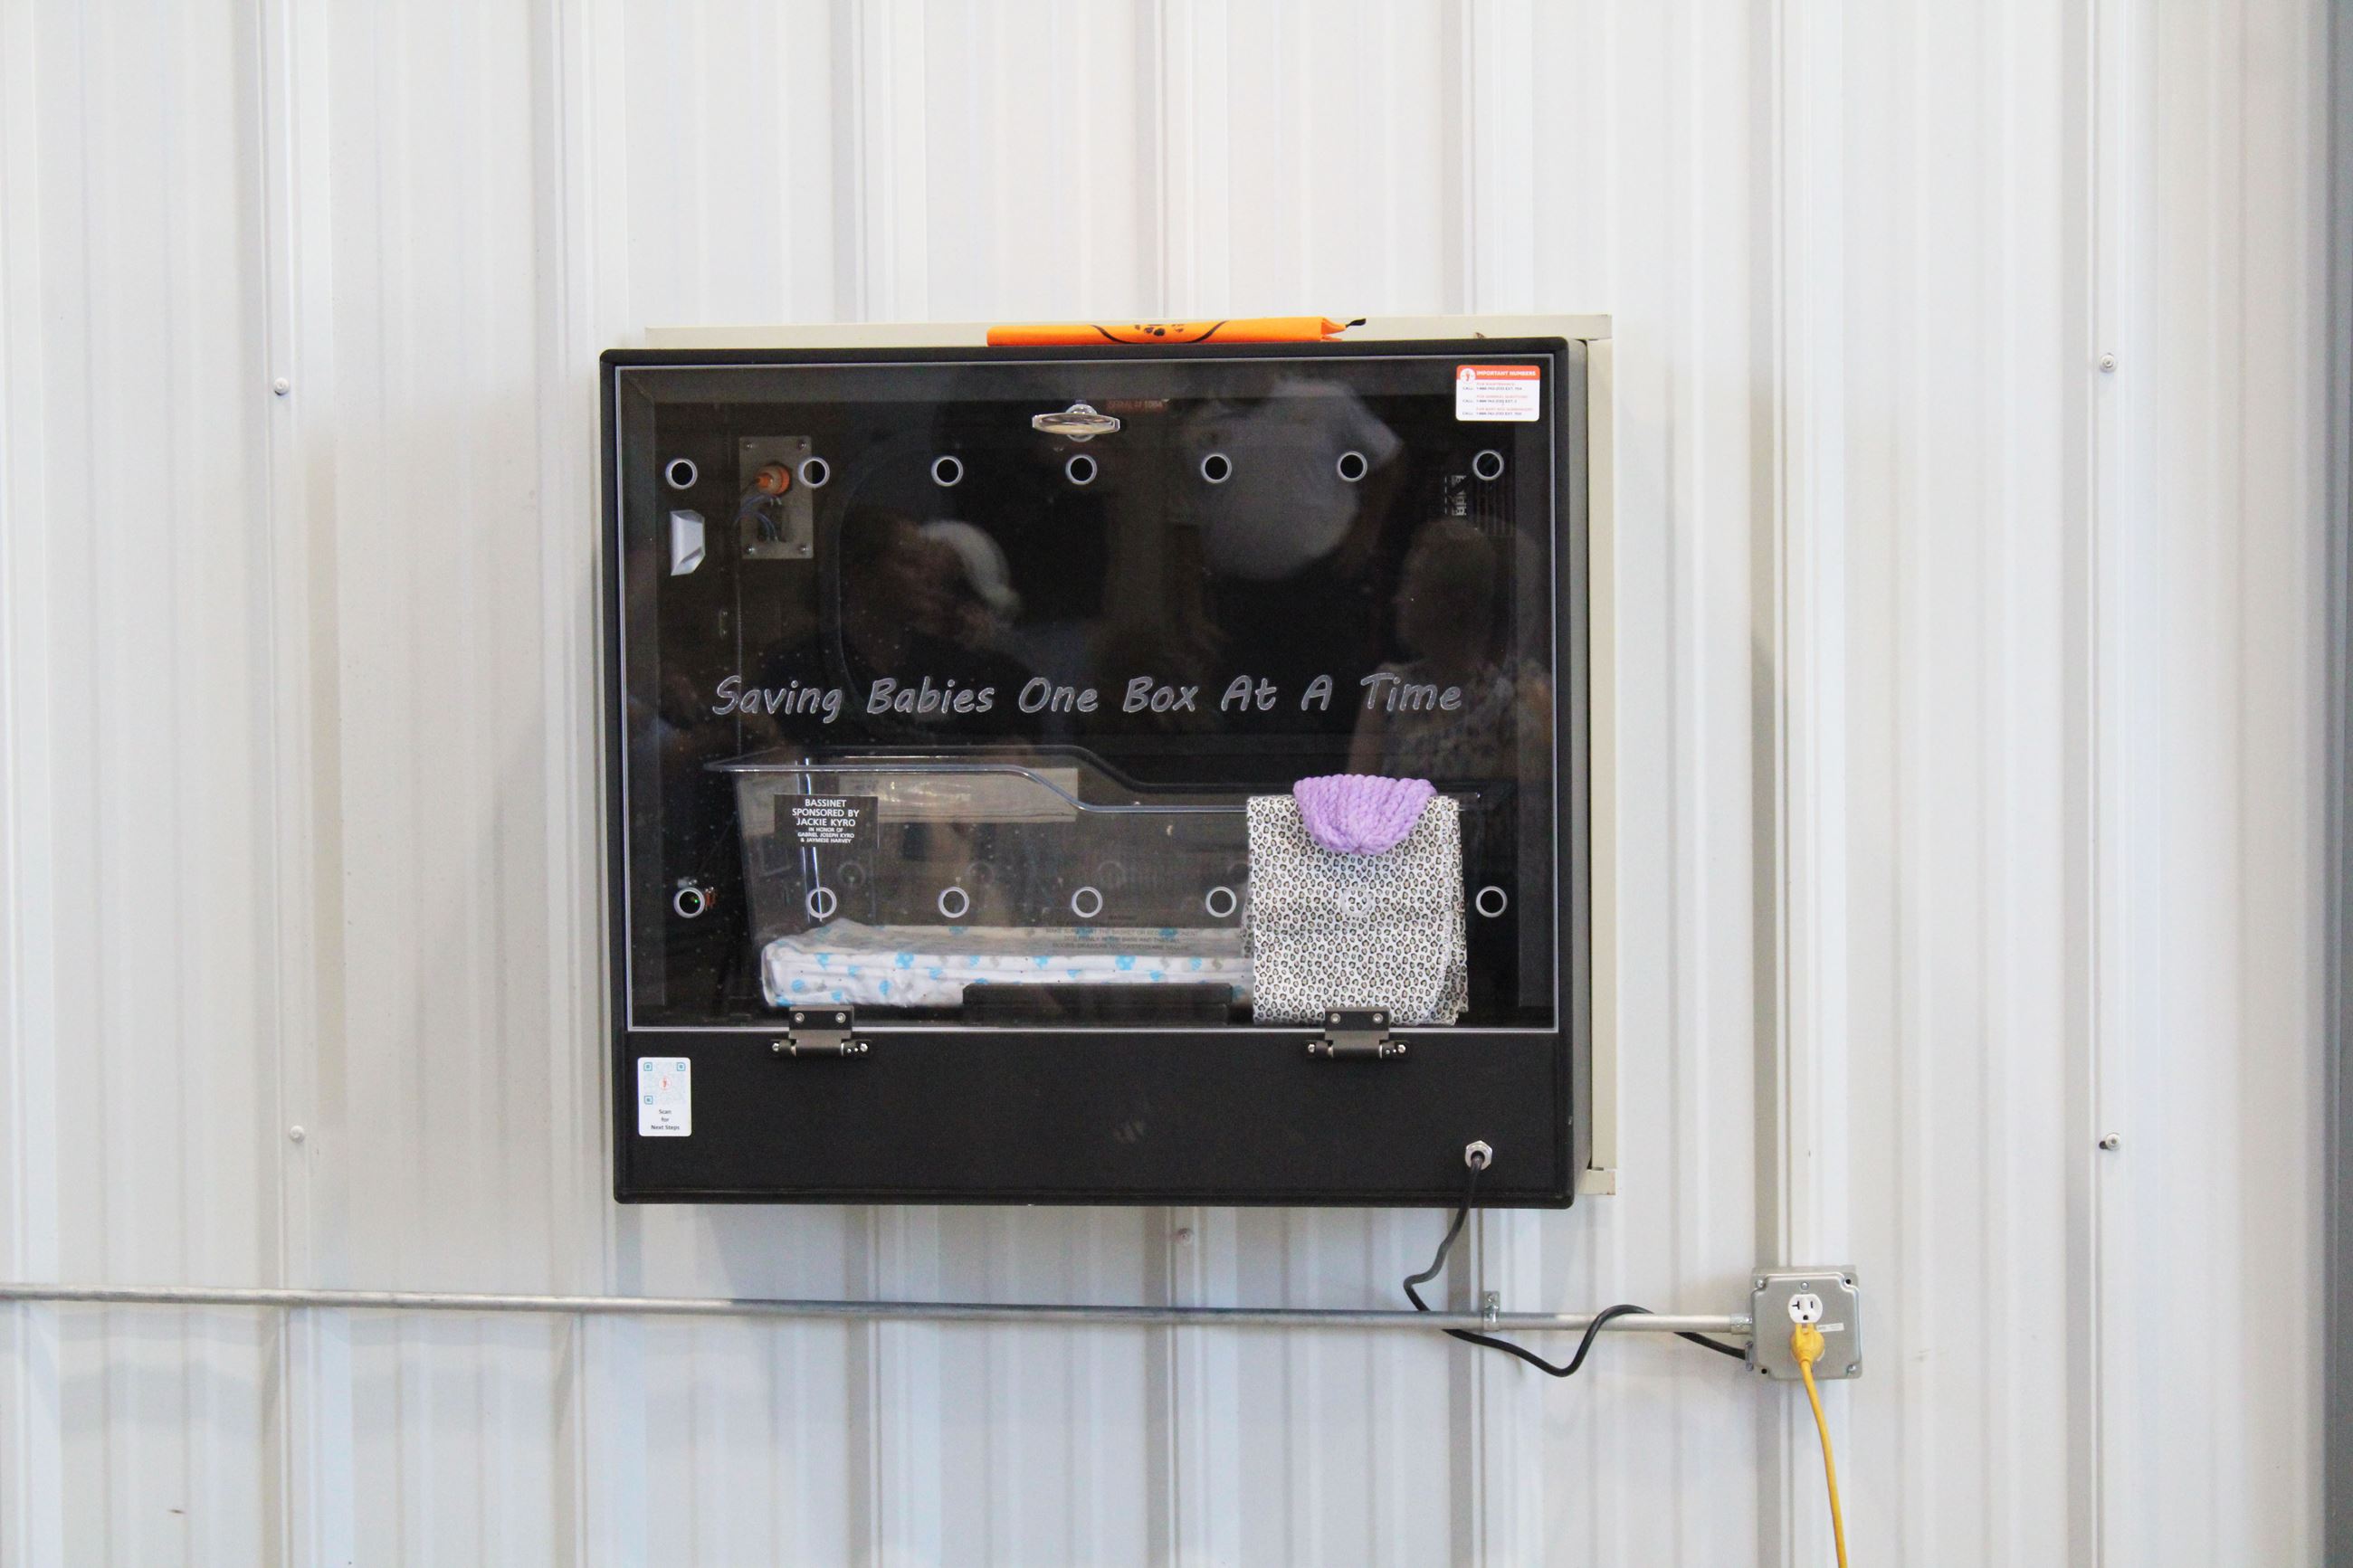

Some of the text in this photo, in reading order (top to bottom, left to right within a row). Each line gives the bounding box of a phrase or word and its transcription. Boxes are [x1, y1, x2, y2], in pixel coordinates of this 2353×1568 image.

[712, 672, 1462, 724] Saving Babies One Box At A Time
[805, 799, 846, 807] BASSINET
[792, 808, 860, 818] SPONSORED BY
[795, 818, 856, 827] JACKIE KYRO
